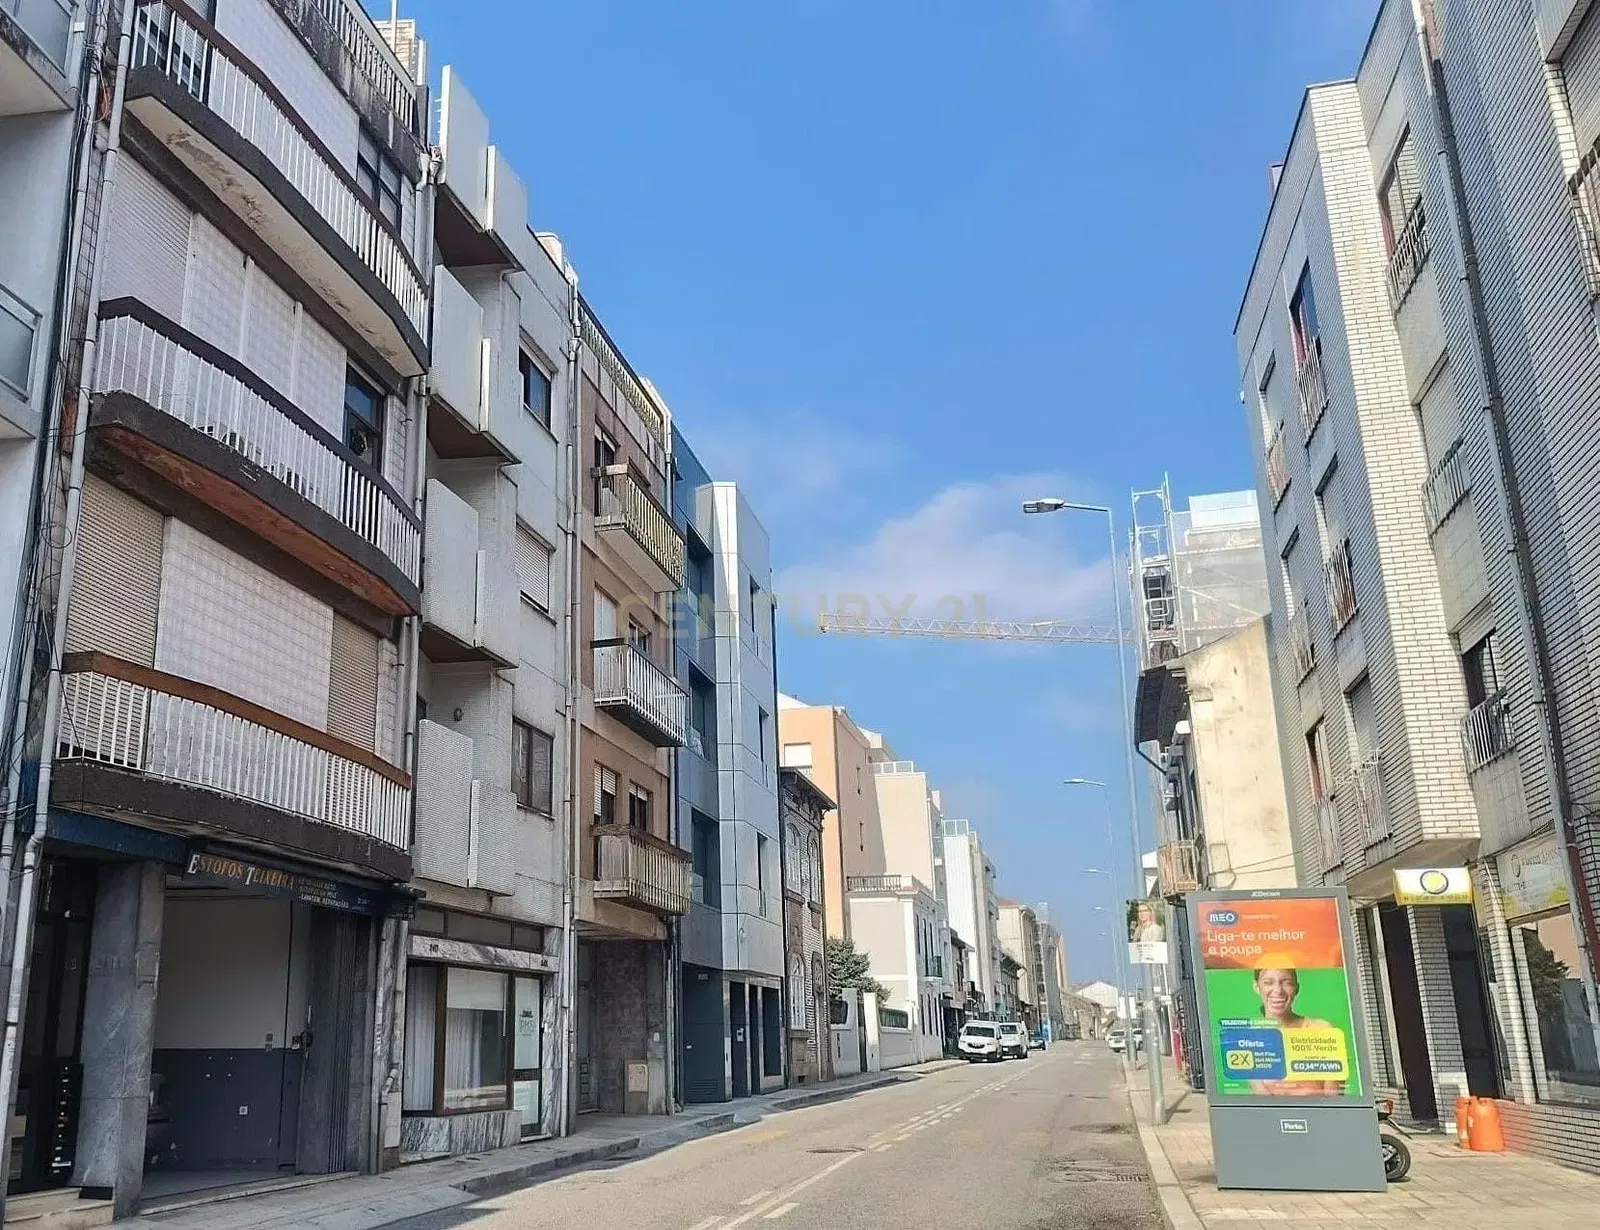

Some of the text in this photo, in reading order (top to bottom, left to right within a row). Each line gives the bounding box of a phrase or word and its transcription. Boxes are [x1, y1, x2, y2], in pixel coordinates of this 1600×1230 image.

[187, 854, 243, 879] ESTOFOS
[244, 866, 294, 889] TEIXEIRA
[1209, 913, 1236, 922] MEO
[1207, 930, 1305, 943] Liga-te melhor
[1220, 945, 1263, 957] poupa
[1238, 1039, 1264, 1047] Oferta
[1230, 1053, 1250, 1066] 2X
